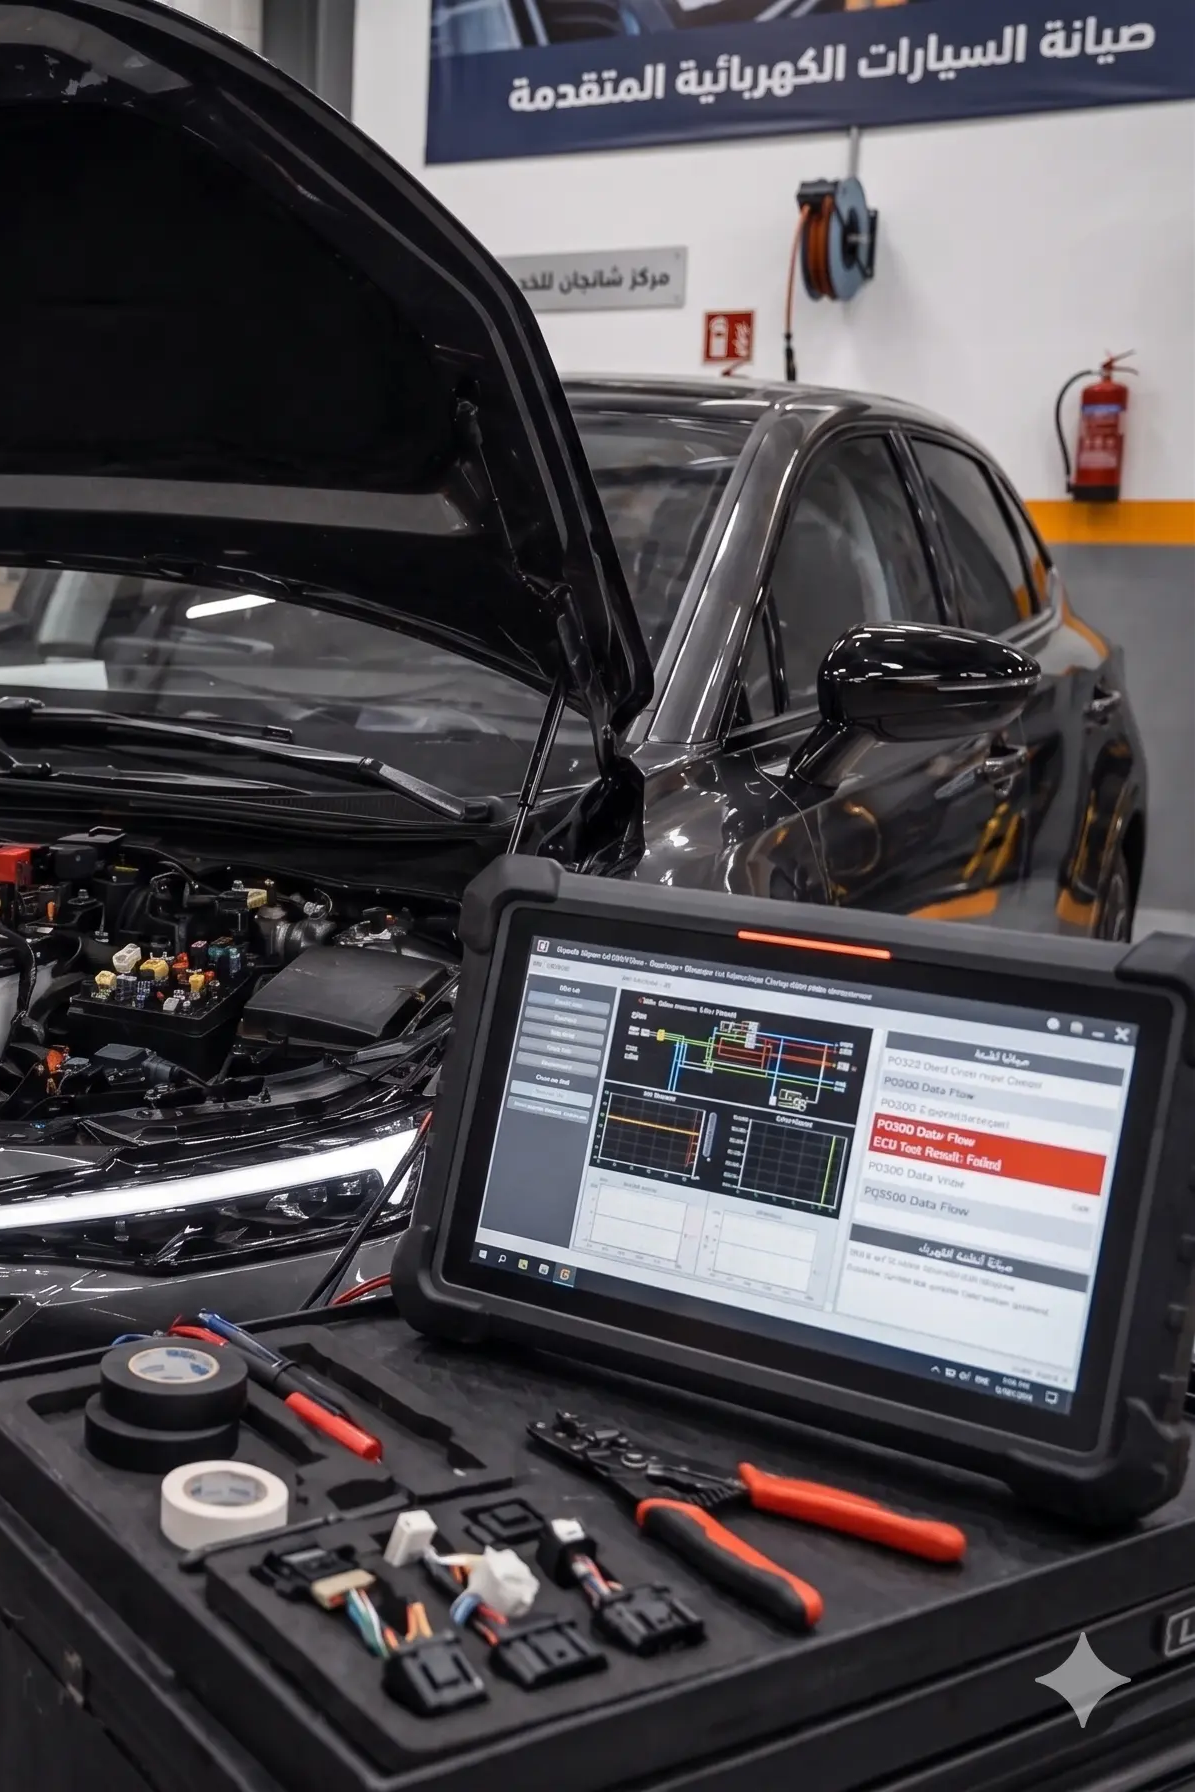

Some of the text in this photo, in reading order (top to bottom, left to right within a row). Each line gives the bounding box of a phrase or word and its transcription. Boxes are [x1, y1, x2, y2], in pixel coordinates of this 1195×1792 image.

[508, 15, 1156, 112] صيانة السيارات الكهربائية المتقدمة
[628, 266, 670, 292] مركز
[872, 1135, 897, 1150] ECU
[947, 1132, 976, 1148] Flow
[907, 1168, 933, 1182] Data
[909, 1195, 936, 1211] Data
[940, 1201, 970, 1217] Flow
